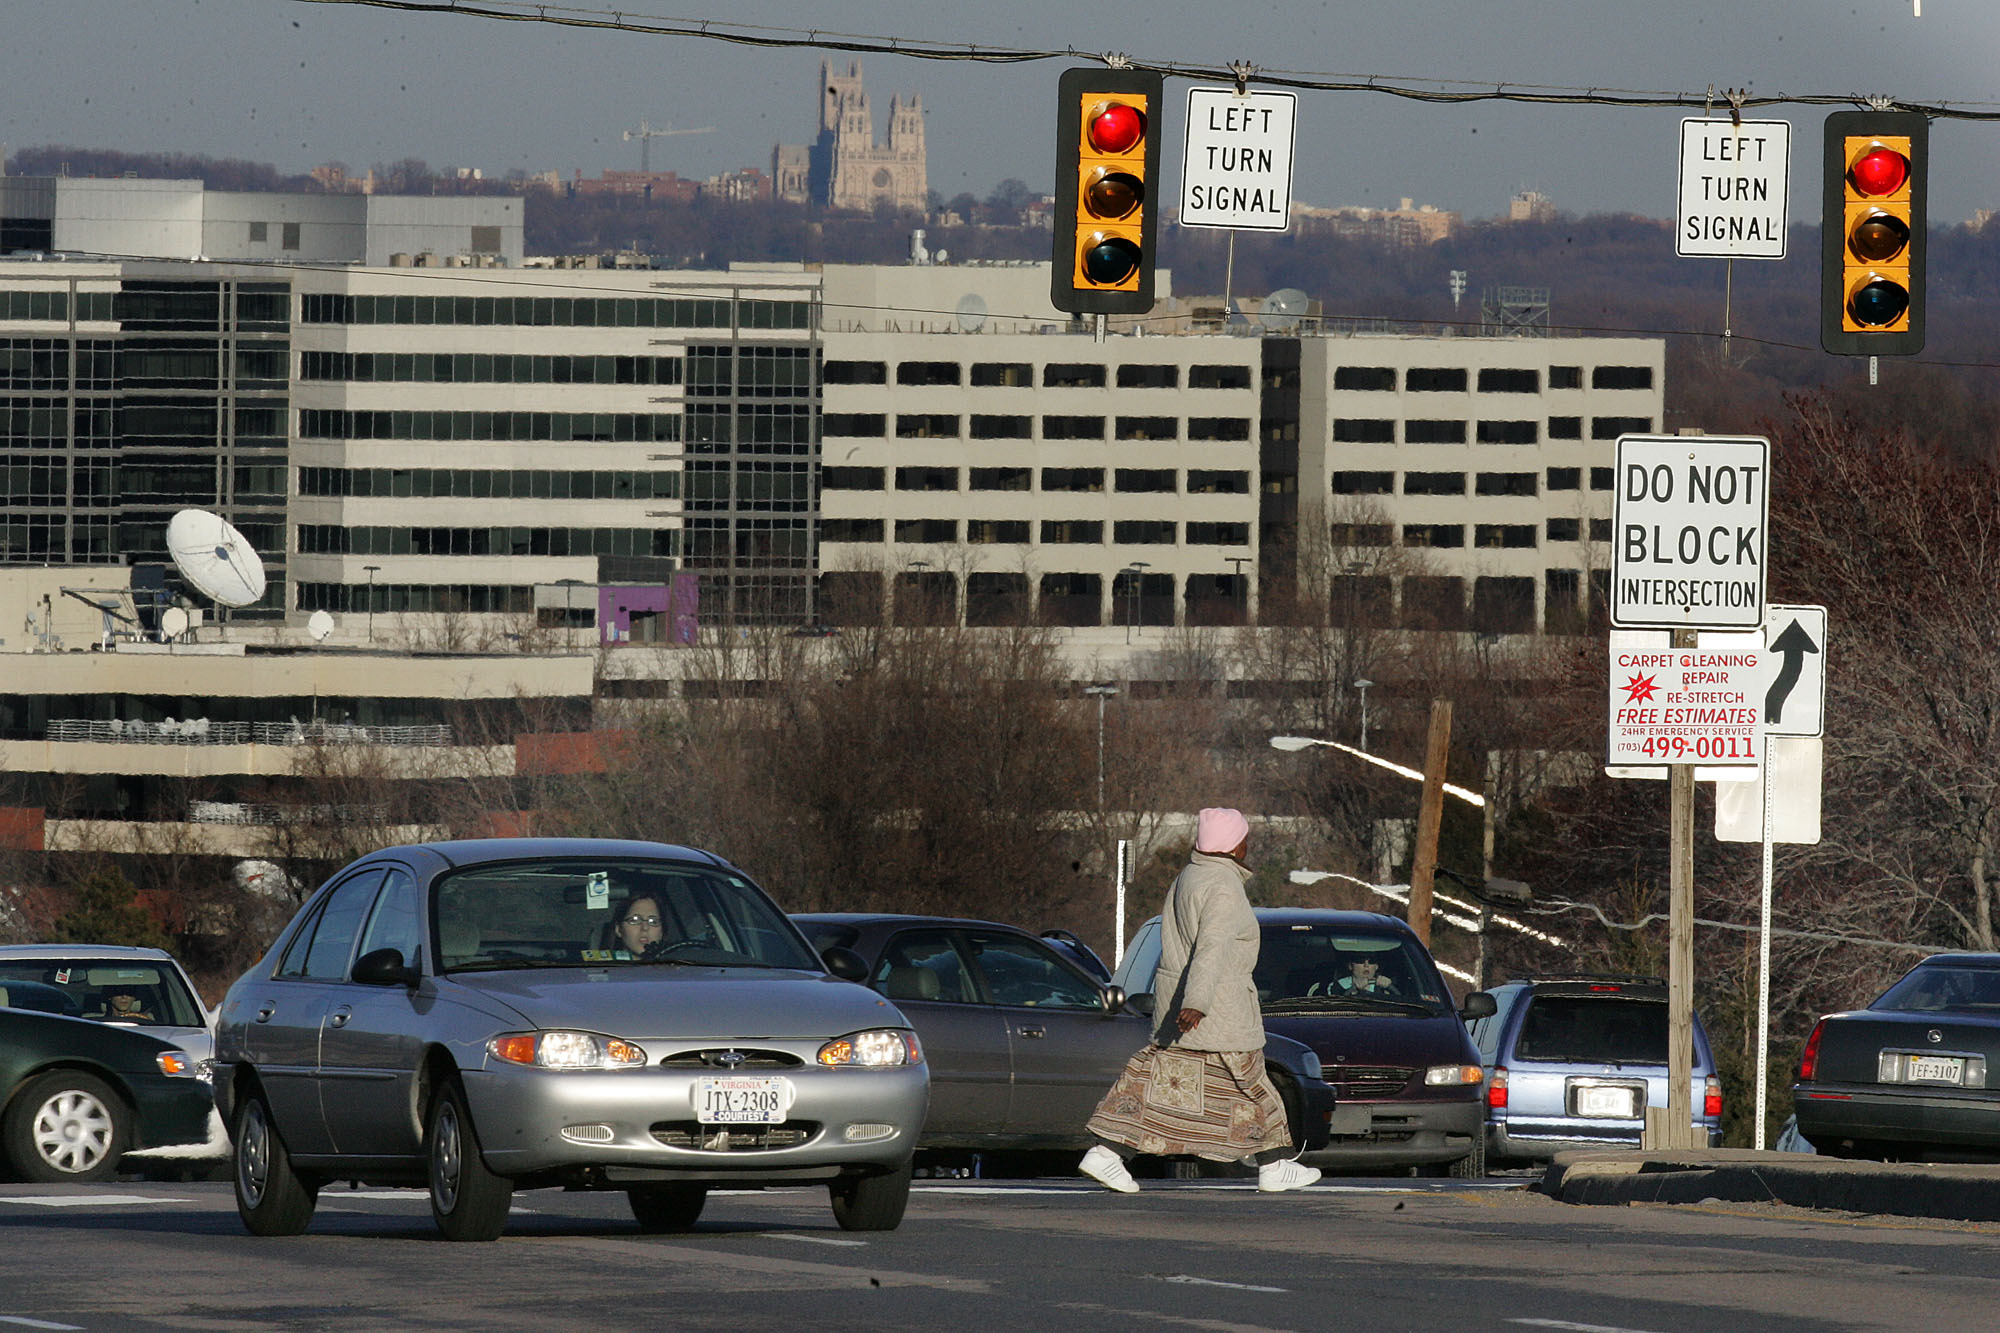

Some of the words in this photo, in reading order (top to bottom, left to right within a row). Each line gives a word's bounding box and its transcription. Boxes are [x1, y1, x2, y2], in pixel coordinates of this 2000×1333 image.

[1209, 106, 1273, 133] LEFT
[1206, 146, 1272, 173] TURN
[1703, 136, 1767, 161] LEFT
[1190, 185, 1281, 213] SIGNAL
[1701, 176, 1767, 201] TURN
[1687, 215, 1778, 241] SIGNAL
[1626, 464, 1674, 503] DO
[1688, 465, 1760, 504] NOT
[1625, 524, 1757, 565] BLOCK
[1621, 578, 1756, 607] INTERSECTION
[1618, 654, 1674, 667] CARPET
[1679, 654, 1758, 667] CLEANING
[1682, 672, 1729, 684] REPAIR
[1667, 692, 1744, 703] RE-STRETCH
[1616, 708, 1659, 724] FREE
[1663, 708, 1757, 724] ESTIMATES
[1621, 727, 1646, 736] 24HR
[1648, 727, 1709, 736] EMERGENCY
[1712, 727, 1754, 736] SERVICE
[1617, 742, 1641, 753] (703)
[1641, 737, 1755, 758] 499-0011
[721, 1081, 762, 1089] VIRGINIA
[704, 1091, 779, 1111] JTX-2308
[718, 1111, 765, 1120] COURTESY
